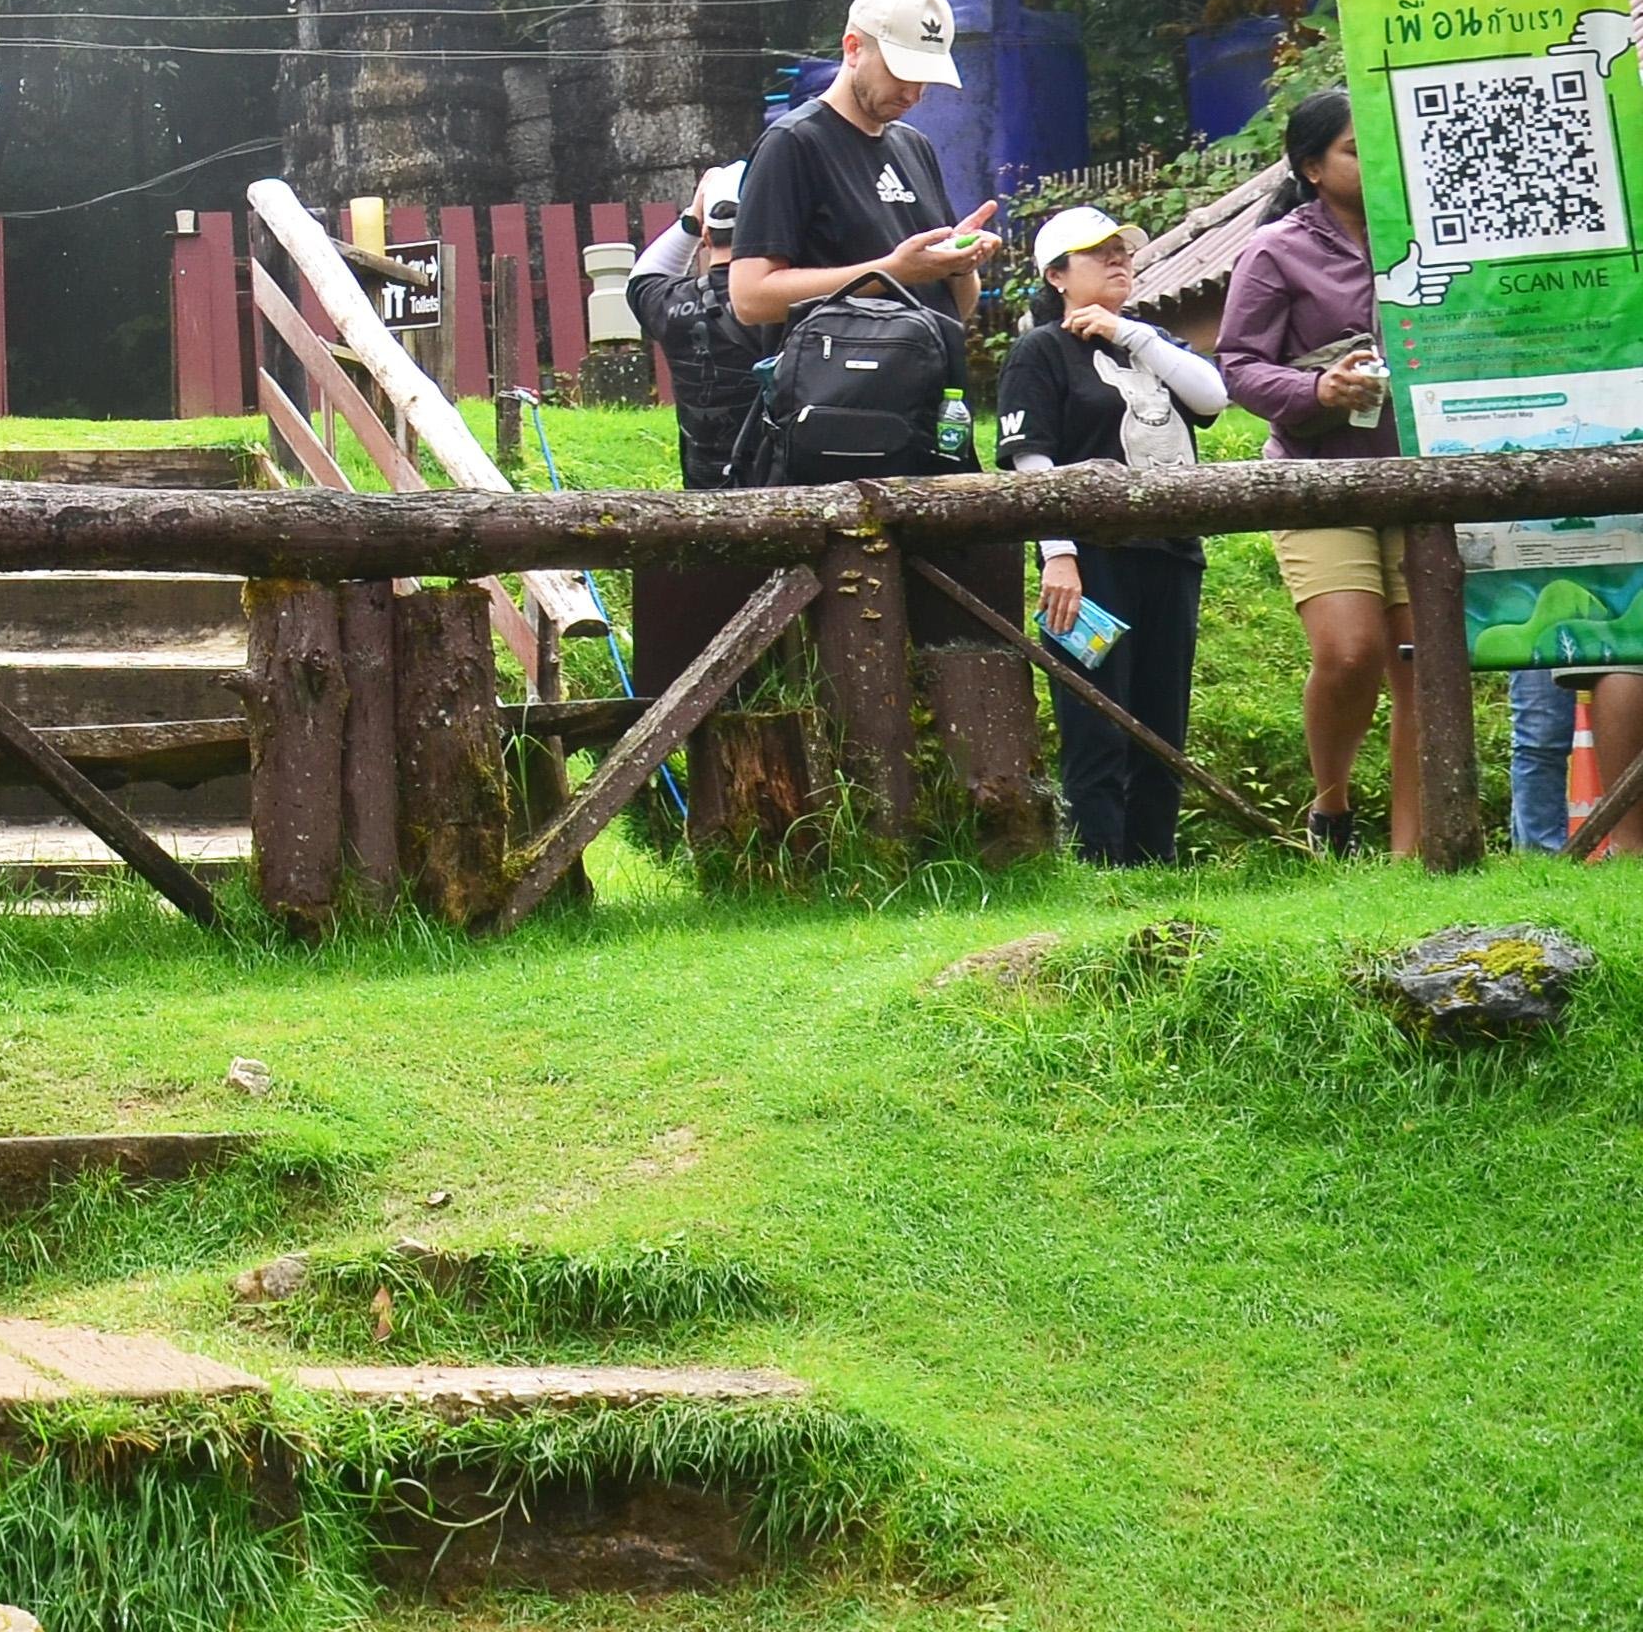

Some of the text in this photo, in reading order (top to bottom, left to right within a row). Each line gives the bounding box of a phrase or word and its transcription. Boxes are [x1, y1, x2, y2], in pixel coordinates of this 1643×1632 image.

[1499, 267, 1610, 295] SCAN ME
[409, 295, 439, 314] Toilets
